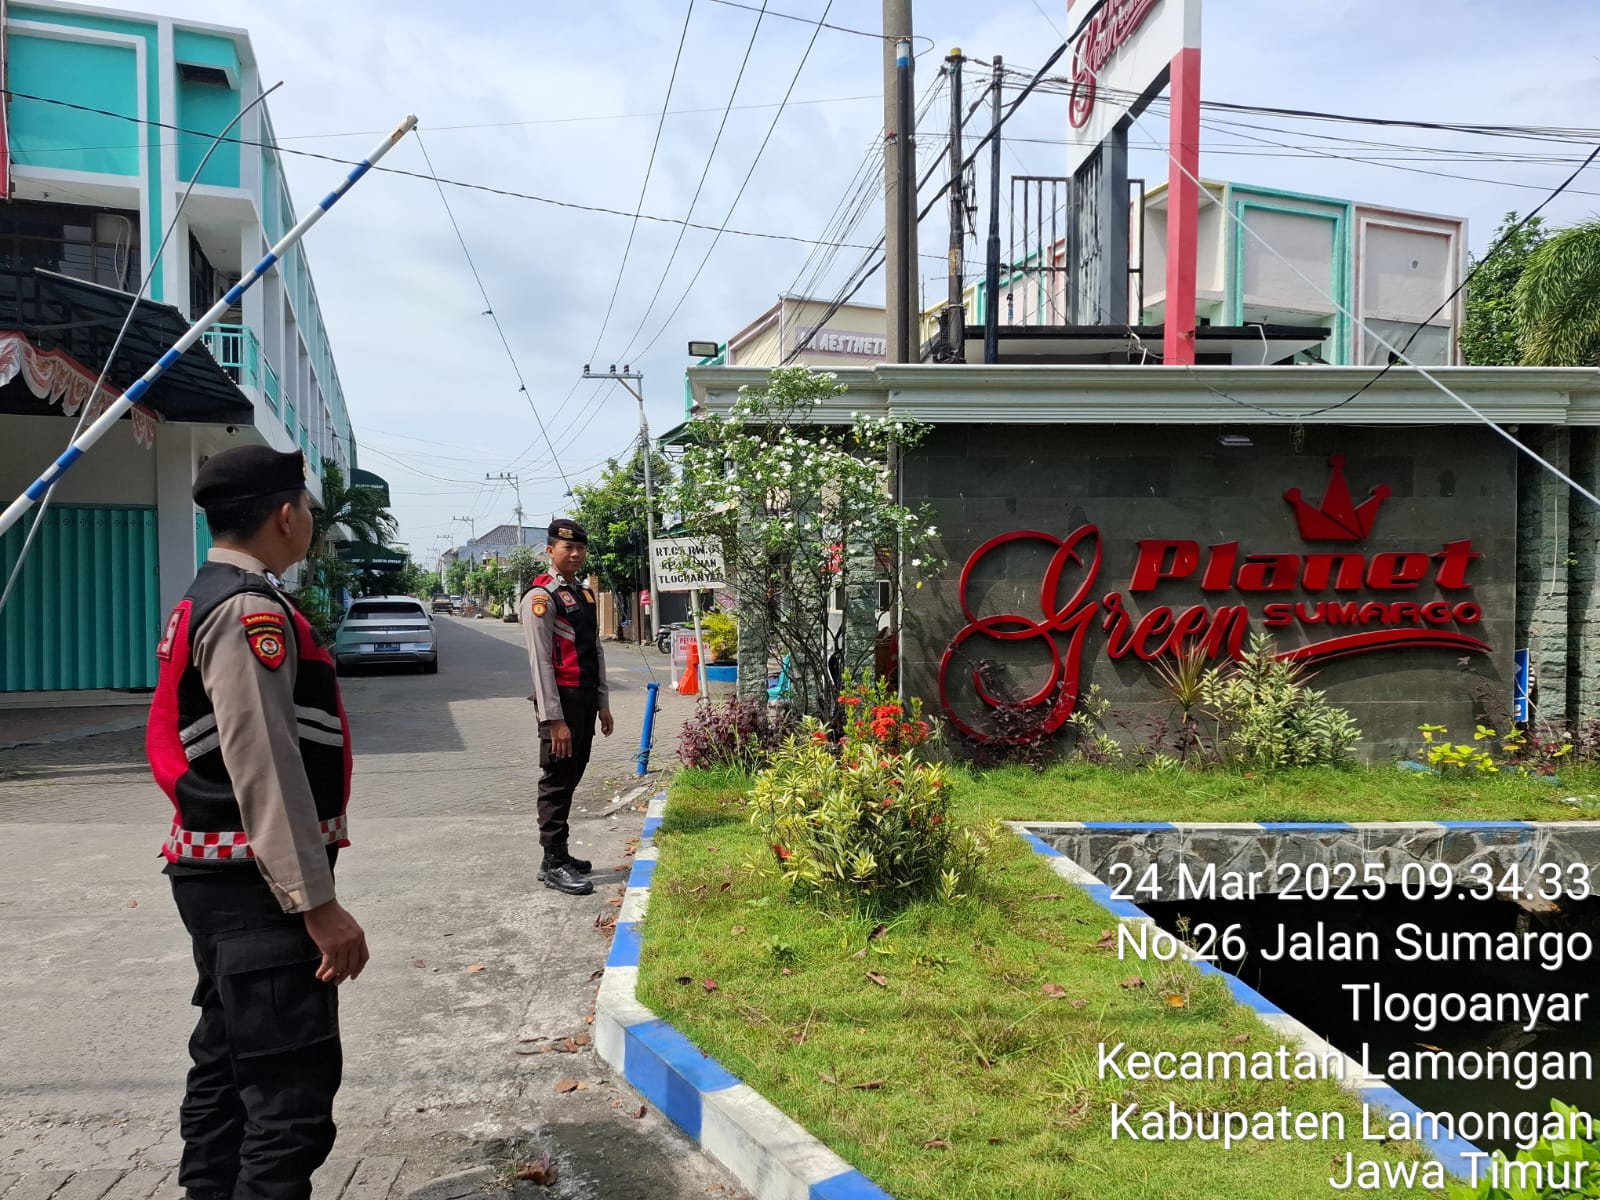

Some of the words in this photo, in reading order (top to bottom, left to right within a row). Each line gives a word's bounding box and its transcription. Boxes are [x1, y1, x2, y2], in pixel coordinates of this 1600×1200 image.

[1128, 538, 1485, 592] Planet
[938, 523, 1250, 744] Green
[1264, 601, 1482, 627] SUMARGO
